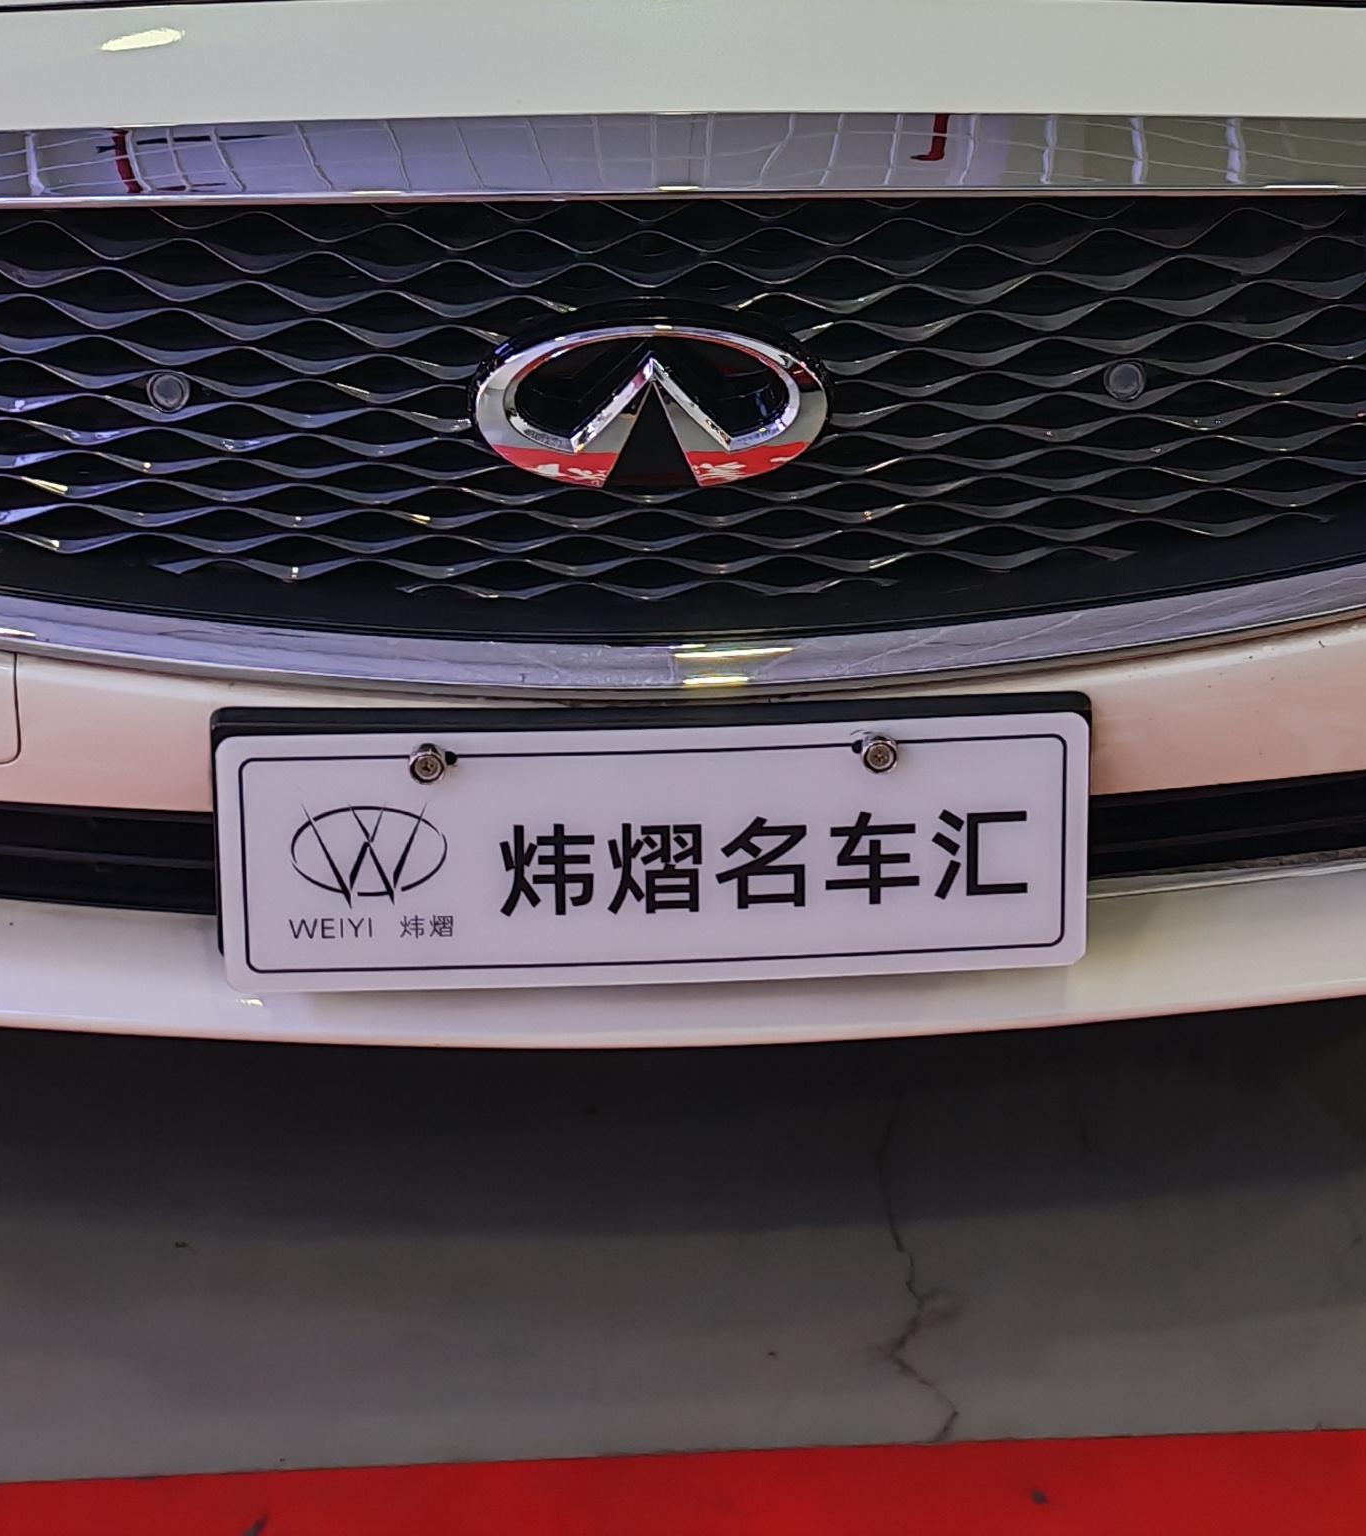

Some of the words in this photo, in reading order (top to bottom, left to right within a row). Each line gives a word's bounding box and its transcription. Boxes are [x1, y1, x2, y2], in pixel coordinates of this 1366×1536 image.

[499, 810, 1029, 918] 炜熠名车汇
[289, 917, 373, 940] WEIYI
[399, 914, 454, 940] 炜熠
